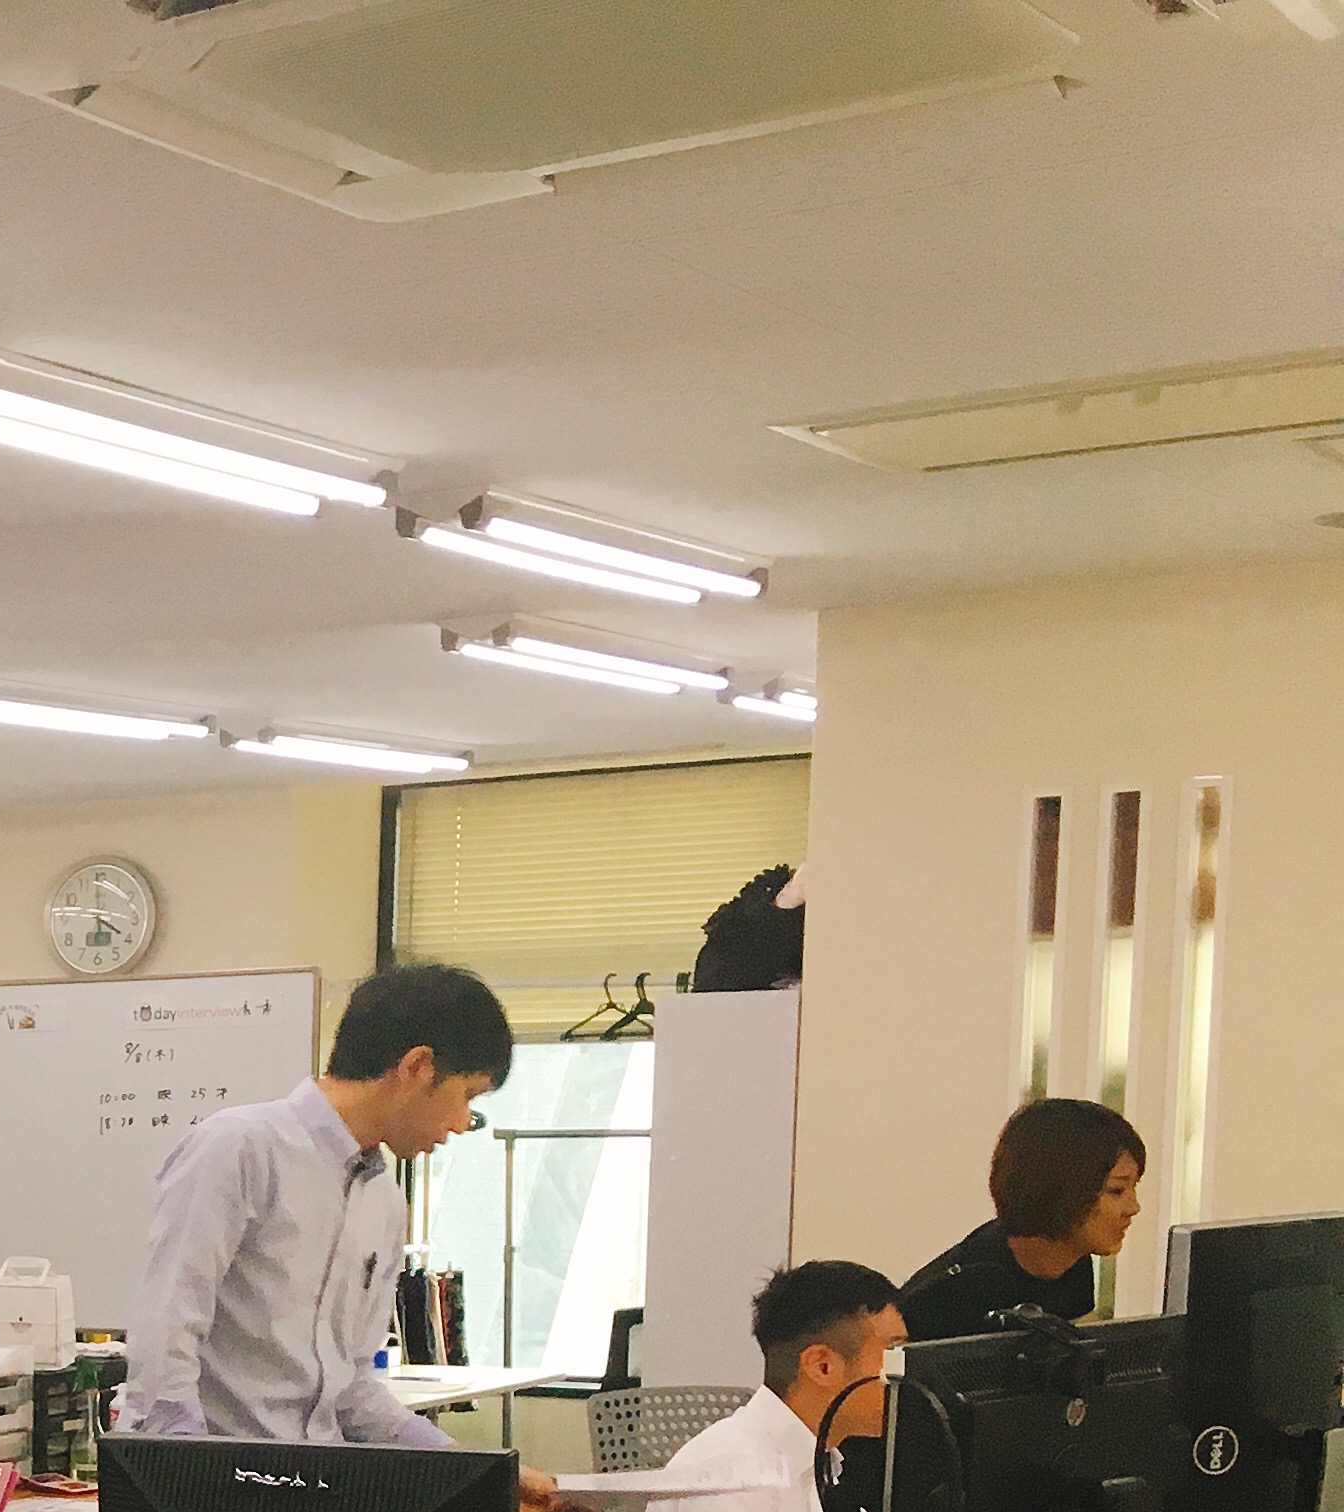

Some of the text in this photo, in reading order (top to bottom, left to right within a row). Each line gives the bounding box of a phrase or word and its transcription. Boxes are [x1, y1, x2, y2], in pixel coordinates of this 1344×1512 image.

[64, 932, 73, 946] 8
[124, 932, 132, 945] 4
[78, 947, 86, 961] 7
[93, 952, 103, 965] 6
[112, 946, 120, 961] 5
[99, 1092, 136, 1105] 10:00
[1210, 1431, 1223, 1469] DELL
